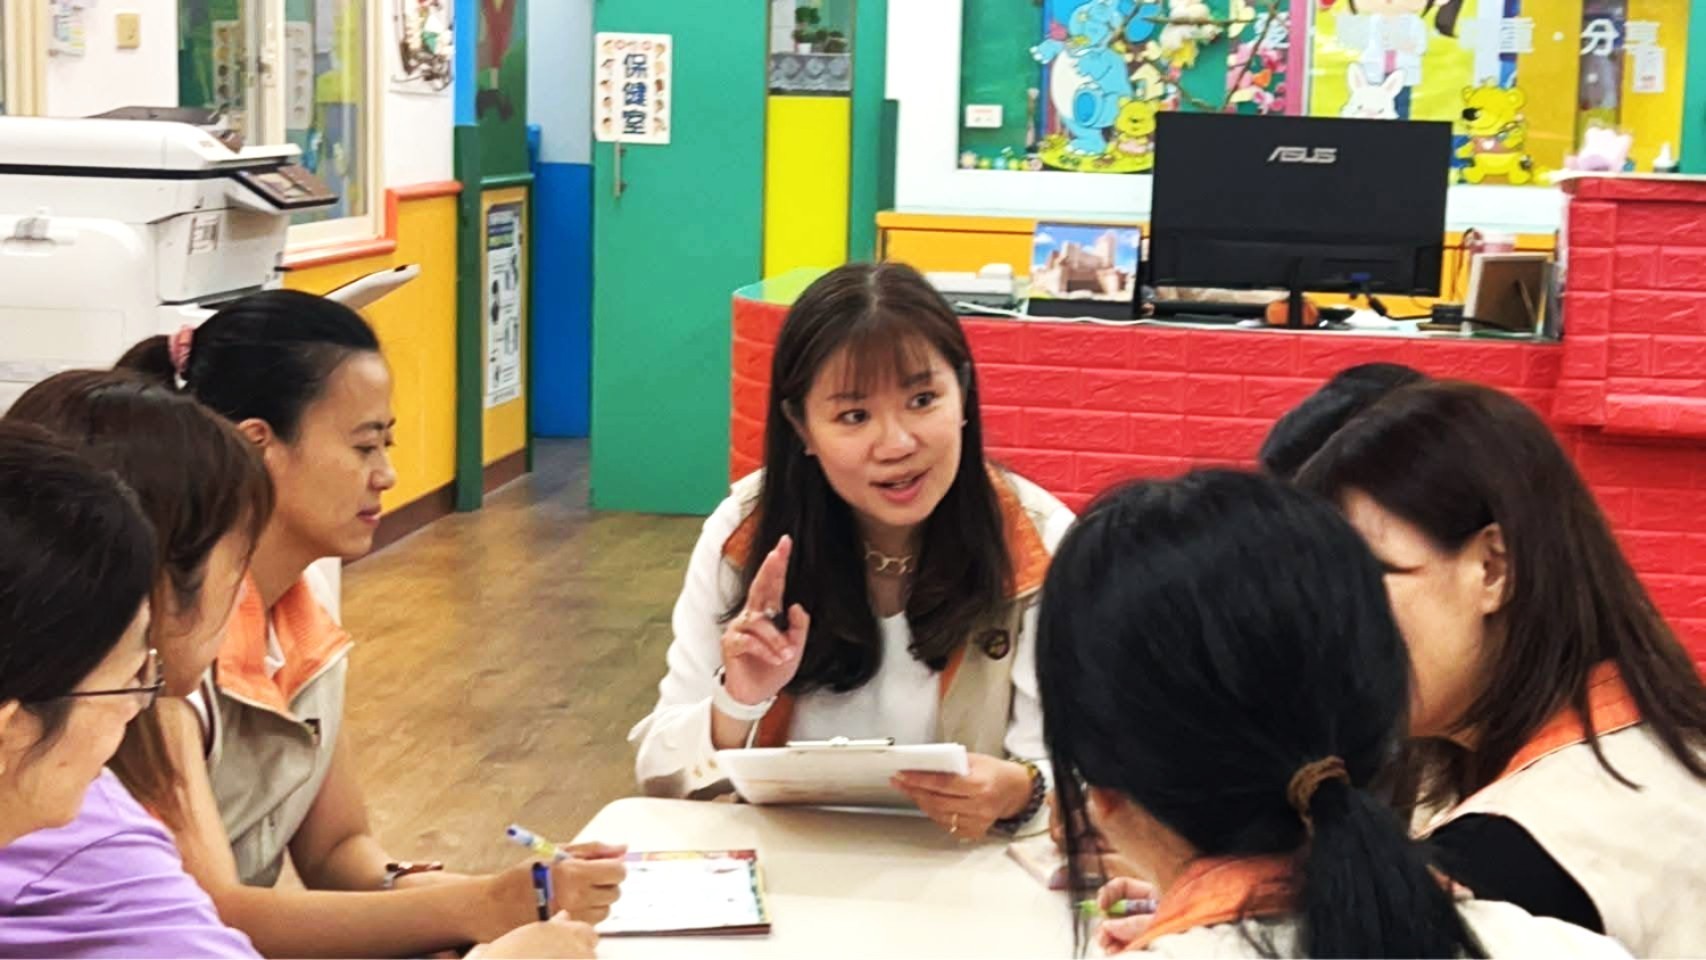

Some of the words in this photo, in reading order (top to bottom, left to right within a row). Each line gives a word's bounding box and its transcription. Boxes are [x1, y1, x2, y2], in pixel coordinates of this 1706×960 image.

[622, 53, 647, 135] 保健室
[1267, 146, 1338, 164] ASUS
